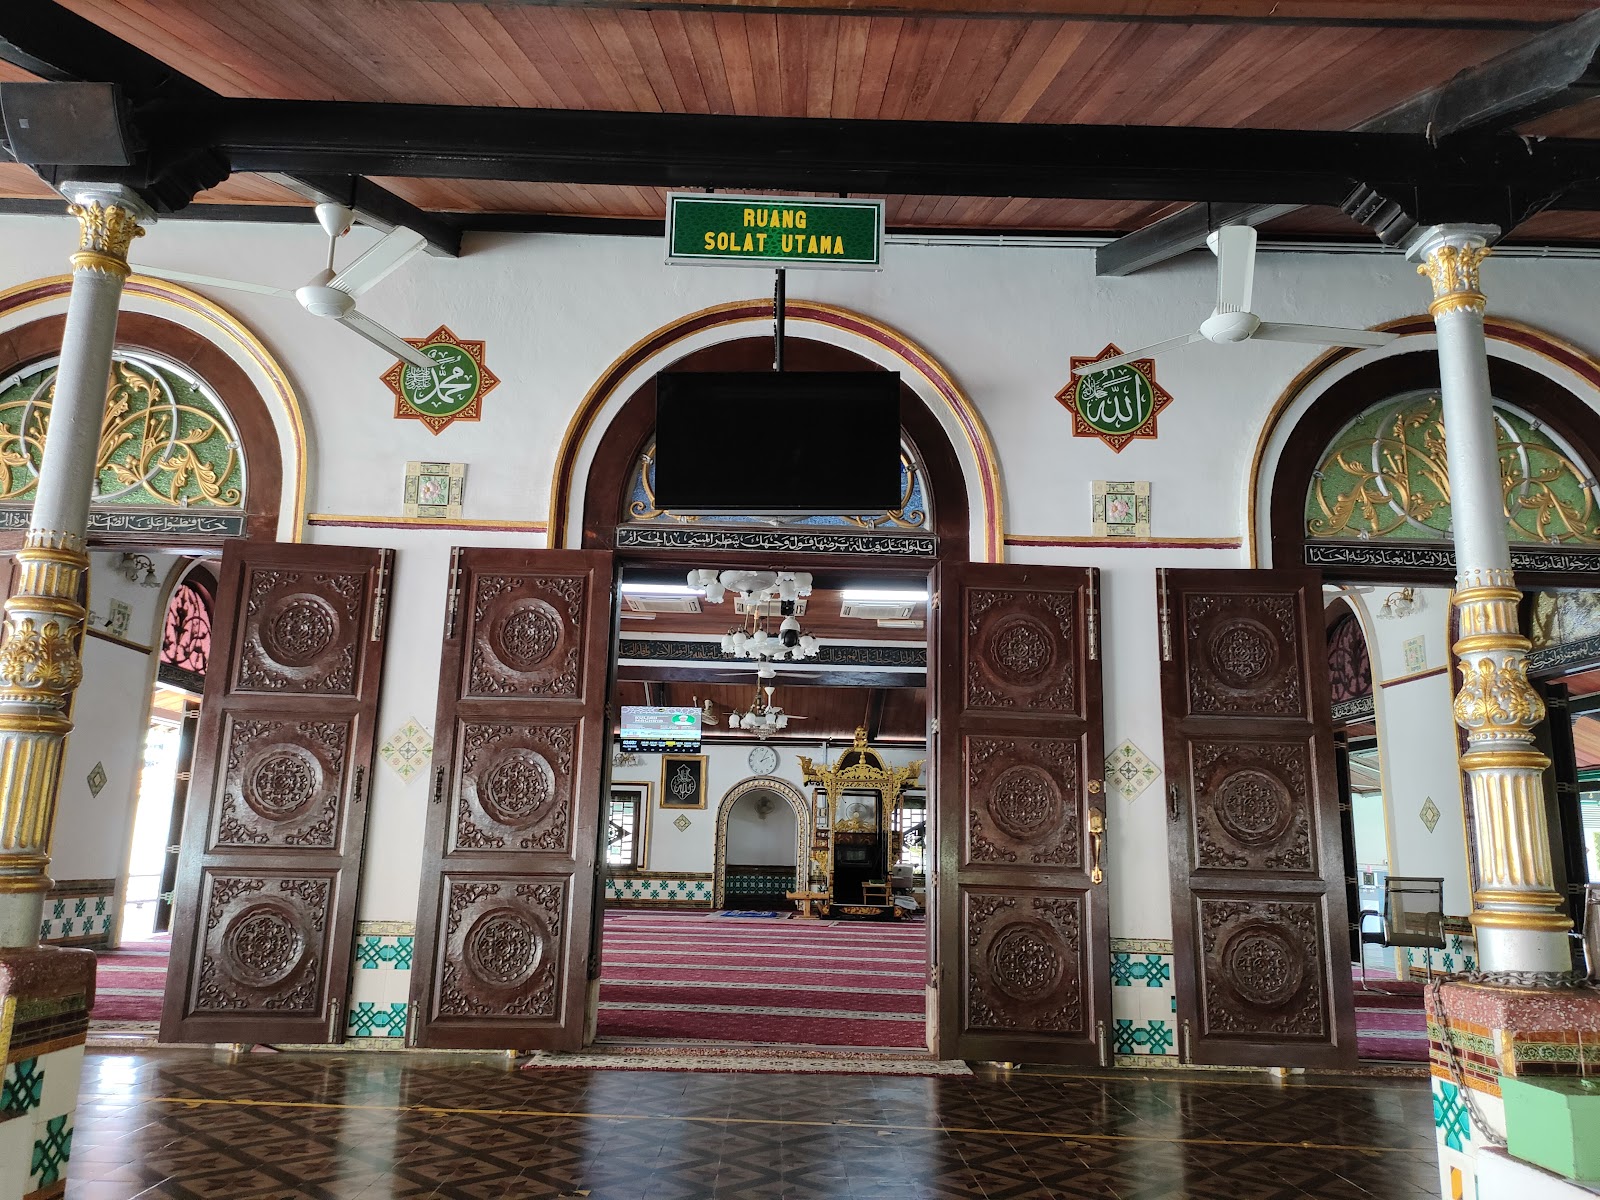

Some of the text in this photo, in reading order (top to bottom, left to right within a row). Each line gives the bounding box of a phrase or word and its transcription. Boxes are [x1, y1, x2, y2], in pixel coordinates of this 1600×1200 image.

[743, 208, 807, 229] RUANG
[704, 231, 845, 255] SOLAT UTAMA
